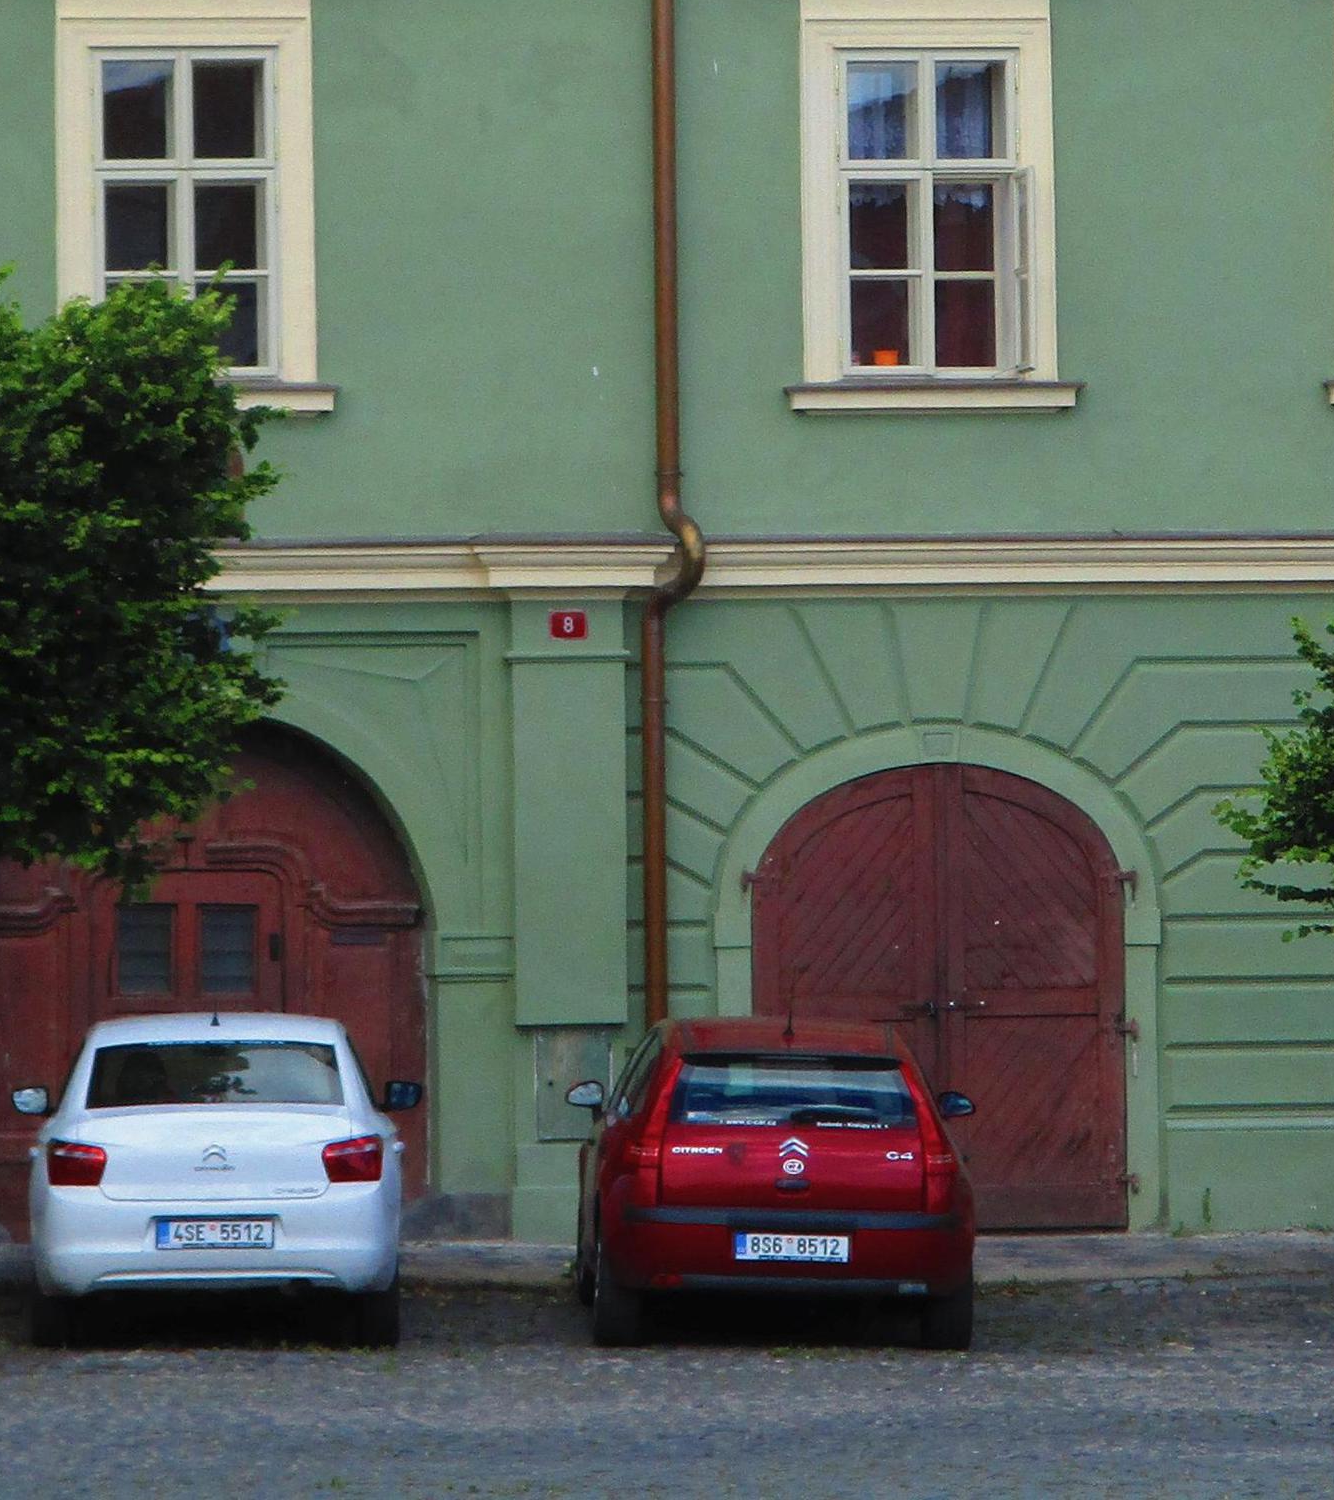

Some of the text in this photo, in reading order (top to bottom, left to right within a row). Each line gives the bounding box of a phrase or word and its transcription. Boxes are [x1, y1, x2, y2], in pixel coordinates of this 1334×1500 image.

[563, 616, 574, 633] 8
[886, 1151, 914, 1160] C4
[174, 1223, 264, 1242] 4SE 5512
[751, 1236, 841, 1256] 8S6 8512
